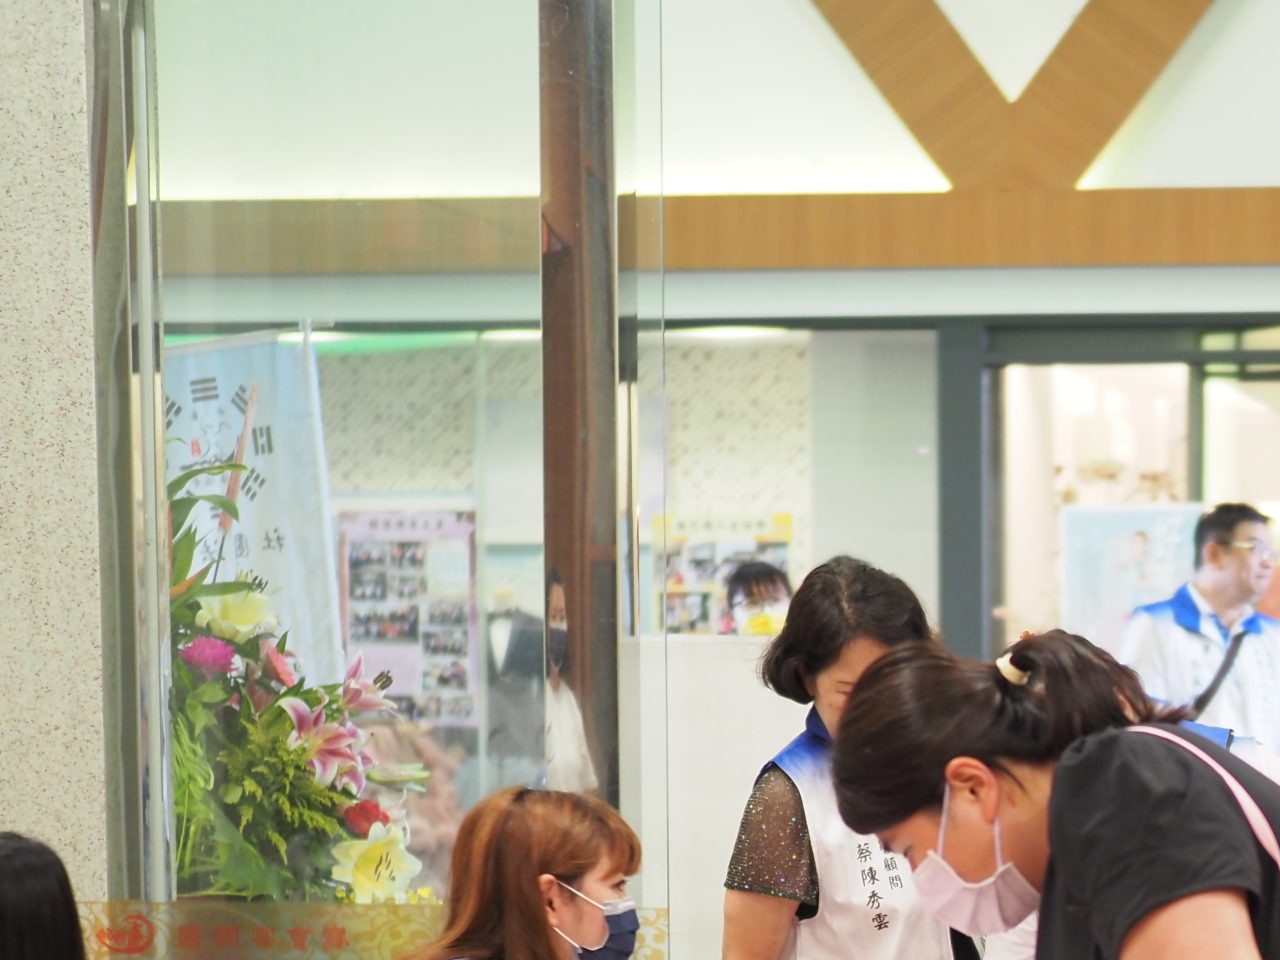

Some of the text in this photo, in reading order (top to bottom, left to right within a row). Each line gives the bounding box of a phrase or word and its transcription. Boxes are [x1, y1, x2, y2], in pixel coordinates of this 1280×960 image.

[856, 842, 890, 931] 蔡陳秀雲
[878, 839, 903, 890] 顧問
